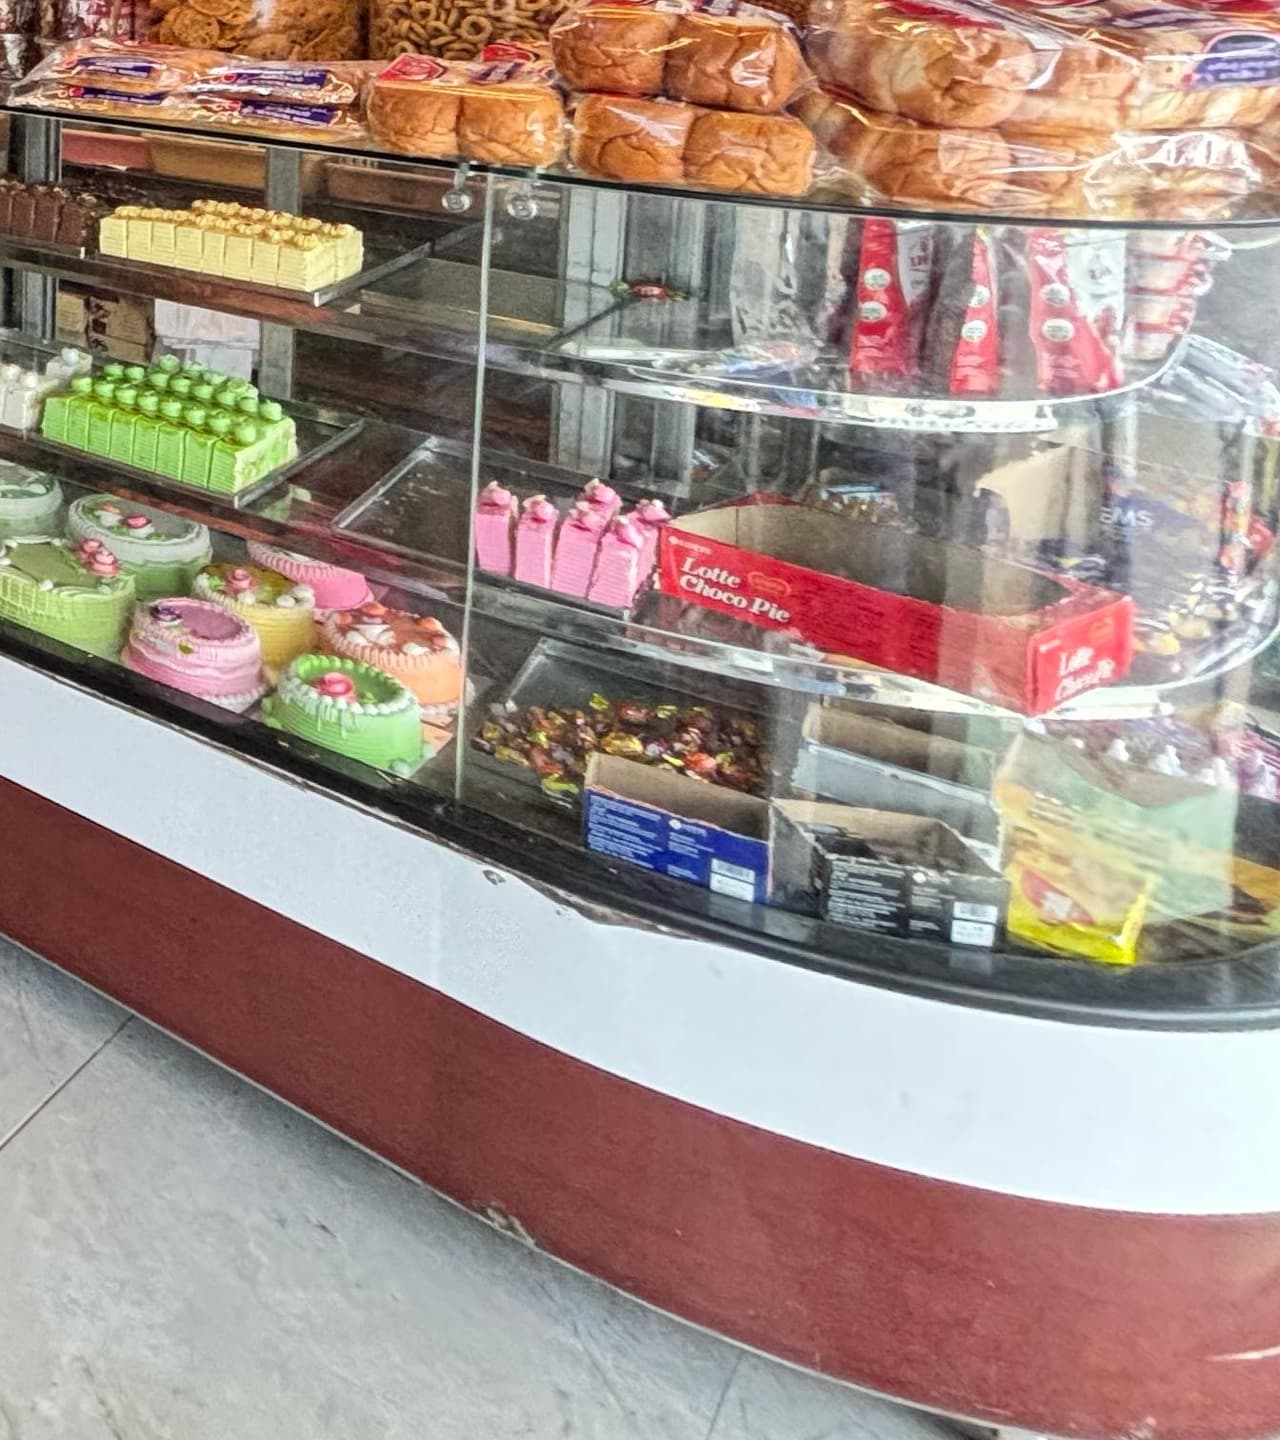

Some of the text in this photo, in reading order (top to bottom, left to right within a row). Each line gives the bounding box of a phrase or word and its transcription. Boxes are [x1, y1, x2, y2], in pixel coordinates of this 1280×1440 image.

[681, 556, 742, 588] Lotte
[679, 574, 748, 609] Choco
[748, 596, 791, 623] Pie
